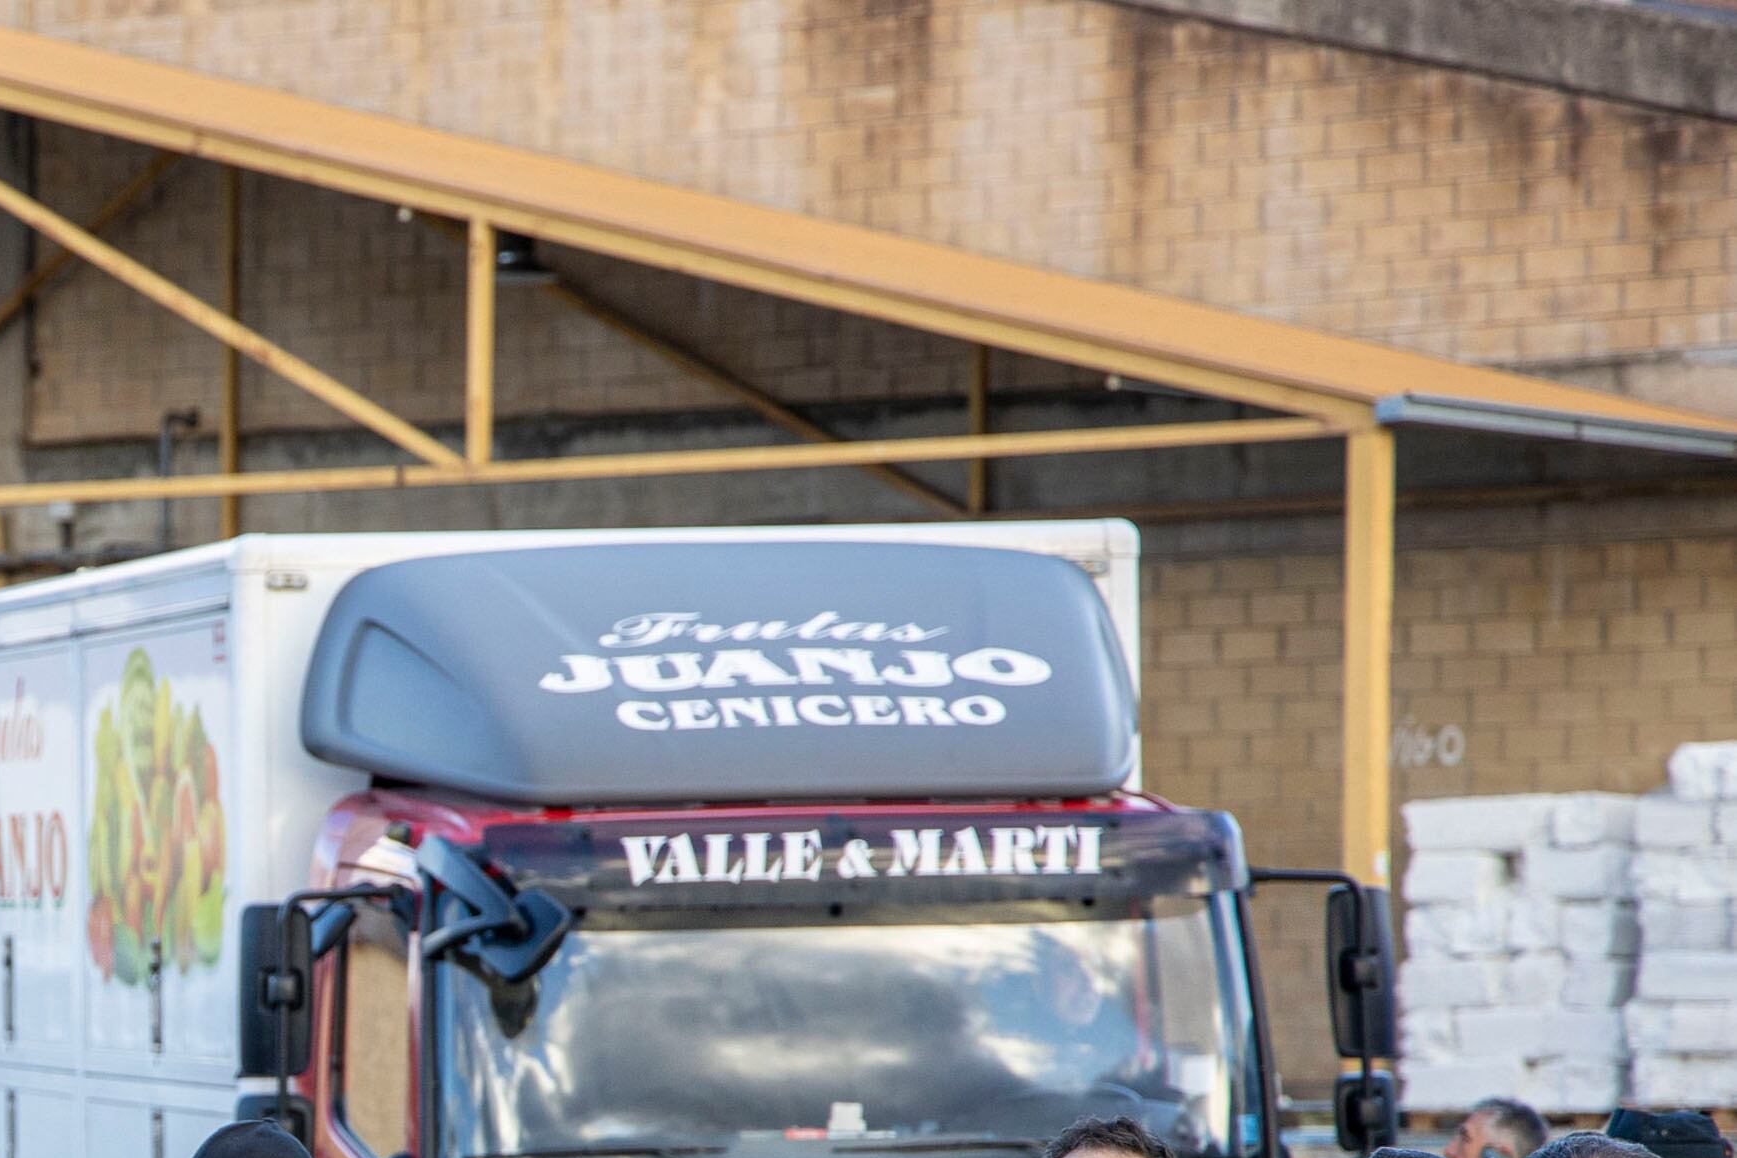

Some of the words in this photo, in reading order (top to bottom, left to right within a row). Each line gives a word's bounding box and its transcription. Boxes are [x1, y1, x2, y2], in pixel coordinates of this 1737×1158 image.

[598, 610, 950, 648] Frutas
[538, 648, 1052, 694] JUANJO
[616, 694, 1007, 731] CENICERO
[619, 828, 823, 887] VALLE
[837, 838, 878, 879] &
[886, 824, 1103, 877] MARTI
